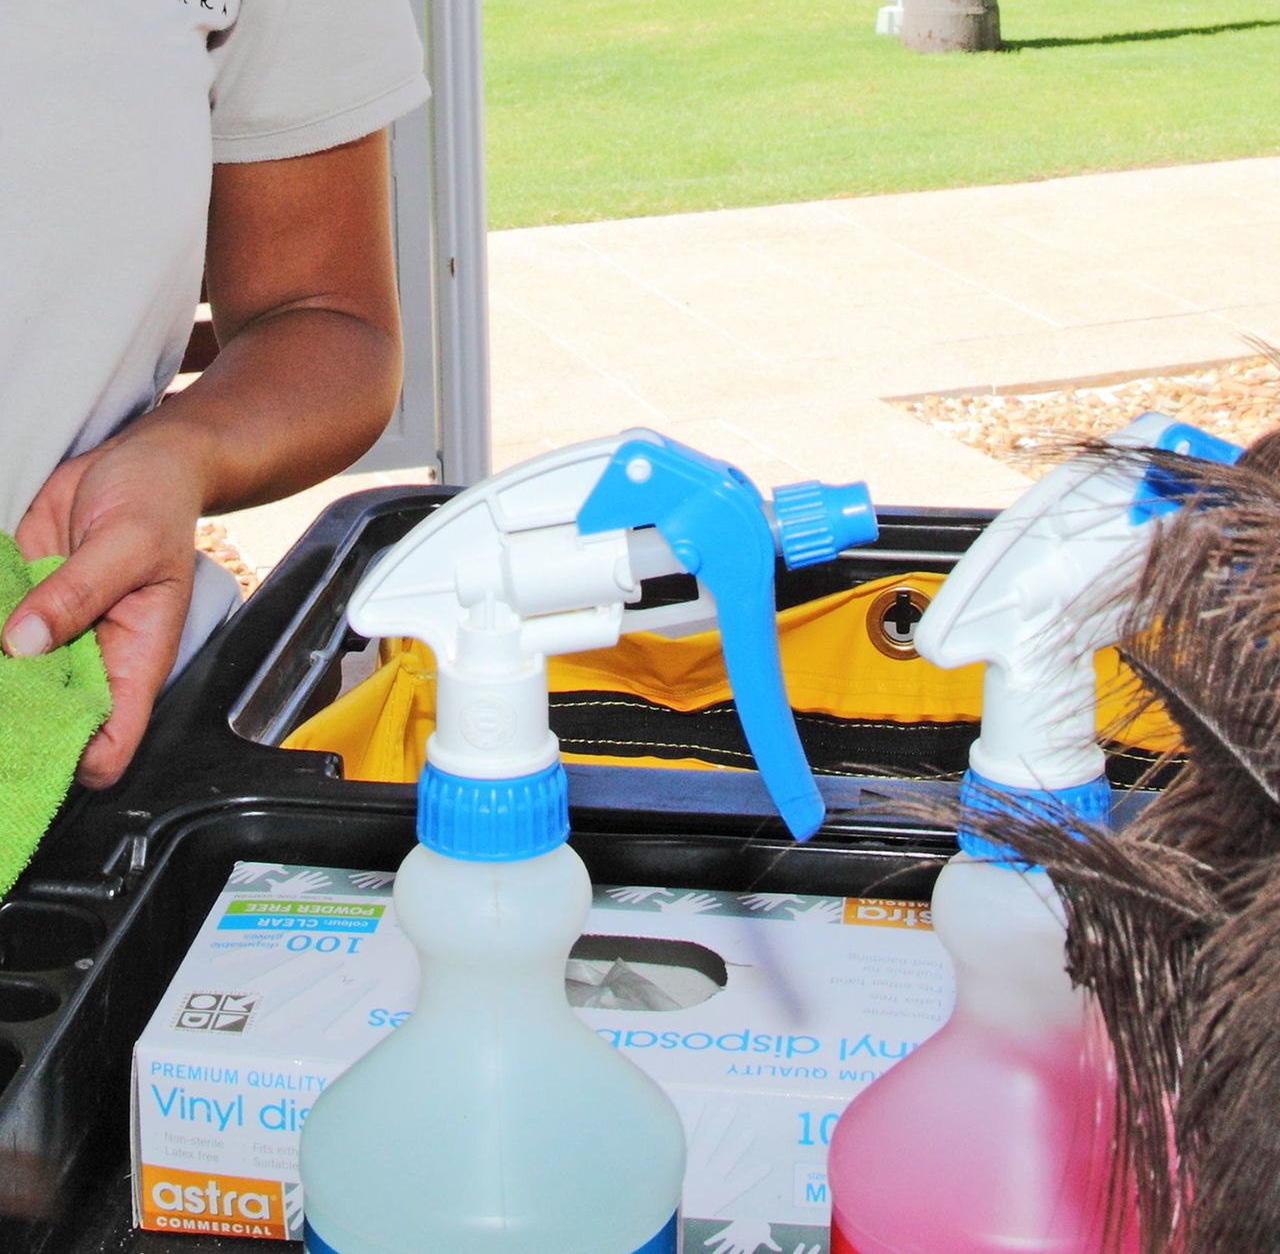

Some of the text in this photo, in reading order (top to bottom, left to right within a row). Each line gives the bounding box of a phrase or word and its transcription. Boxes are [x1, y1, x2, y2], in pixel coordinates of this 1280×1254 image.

[244, 903, 375, 916] POWDER FREE
[257, 917, 320, 928] CLEAR
[286, 934, 363, 955] 100
[151, 1062, 327, 1092] PREMIUM QUALITY
[725, 1064, 828, 1080] QUALITY
[151, 1084, 243, 1132] Vinyl
[151, 1180, 270, 1220] astra
[806, 1182, 827, 1203] M
[156, 1215, 272, 1236] COMMERCIAL
